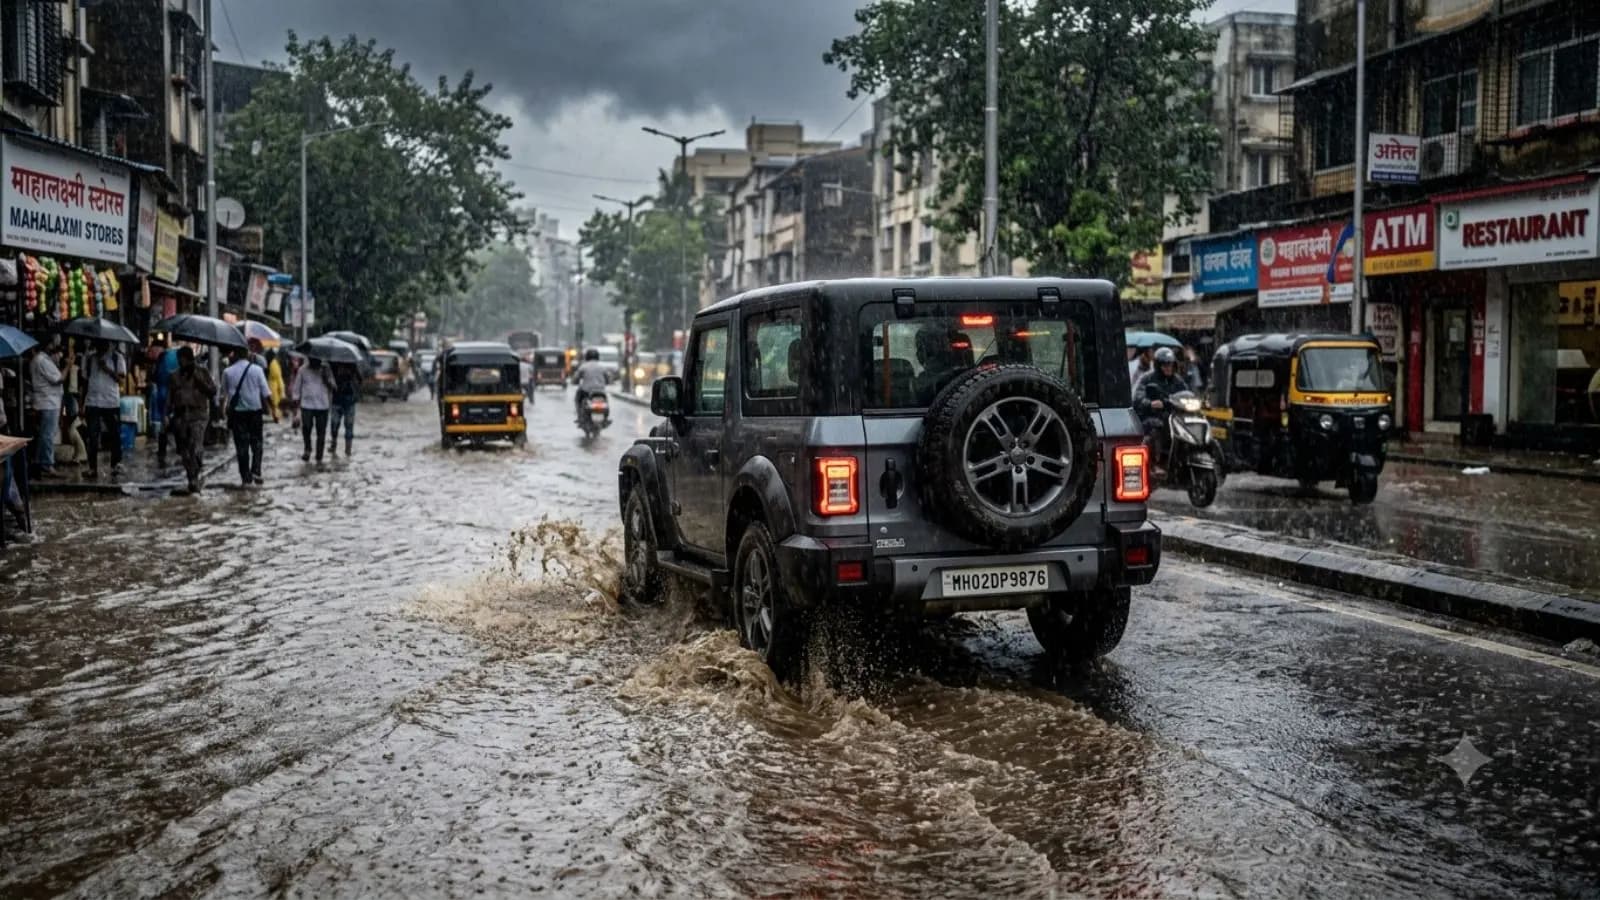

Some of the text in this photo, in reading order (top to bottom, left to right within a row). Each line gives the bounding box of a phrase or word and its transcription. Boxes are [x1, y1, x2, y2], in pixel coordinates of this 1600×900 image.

[10, 206, 82, 238] MAHALAXMI
[85, 221, 124, 246] STORES
[1371, 213, 1427, 251] ATM
[1463, 208, 1589, 248] RESTAURANT
[952, 570, 1046, 592] MH02DP9876
